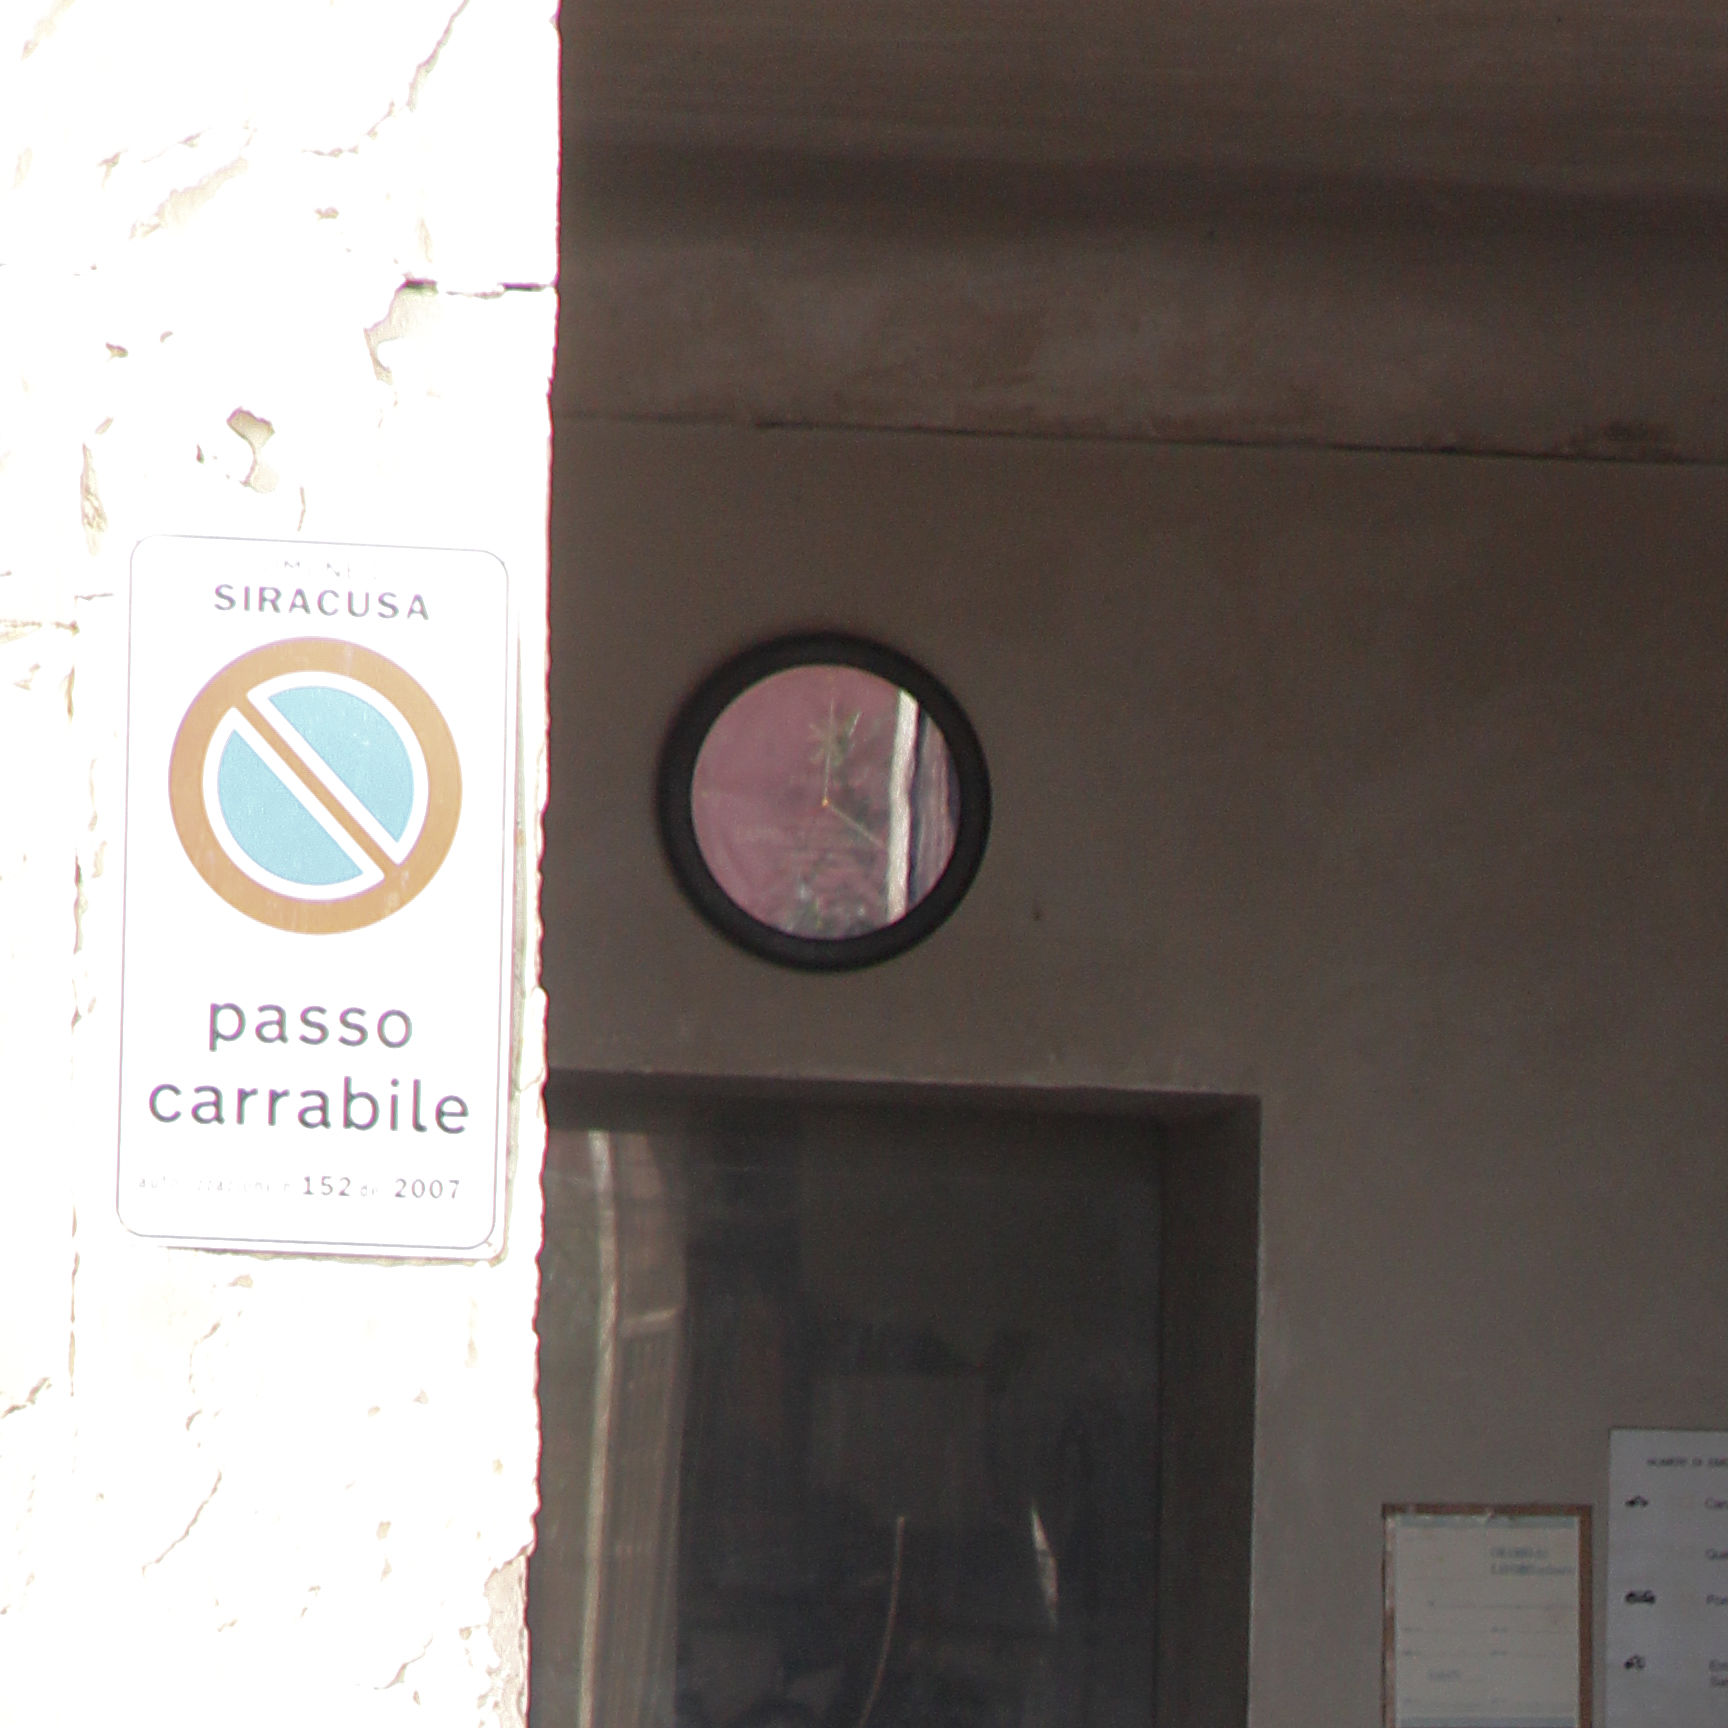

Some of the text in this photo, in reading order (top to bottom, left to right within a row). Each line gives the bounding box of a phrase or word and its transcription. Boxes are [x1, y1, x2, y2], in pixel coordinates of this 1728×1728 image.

[214, 583, 430, 621] SIRACUSA
[208, 1002, 413, 1052] passo
[149, 1076, 470, 1134] carrabile
[302, 1175, 352, 1198] 152
[394, 1177, 461, 1200] 2007
